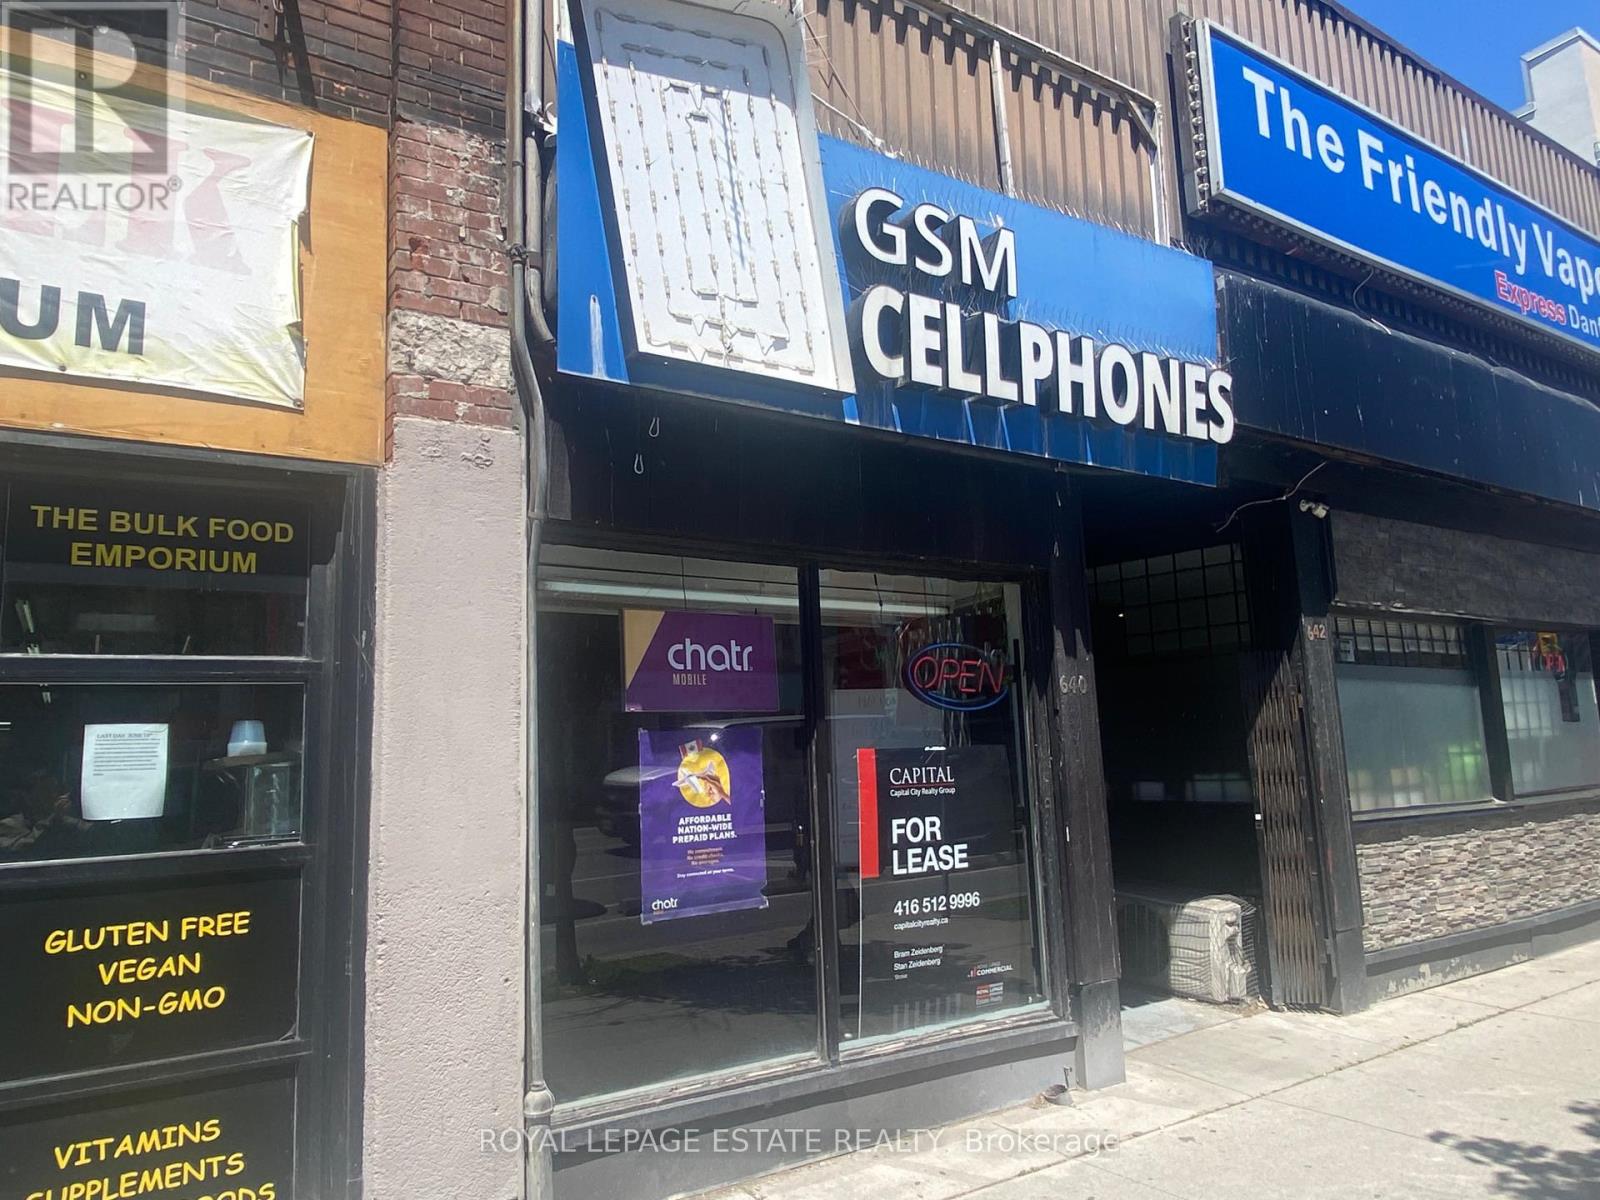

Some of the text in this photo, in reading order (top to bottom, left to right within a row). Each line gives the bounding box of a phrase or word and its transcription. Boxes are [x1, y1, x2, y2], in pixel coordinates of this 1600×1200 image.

[1242, 66, 1600, 304] The Friendly Vap
[854, 186, 1018, 298] GSM
[1494, 269, 1600, 338] Express Dan
[861, 284, 1235, 445] CELLPHONES
[30, 504, 295, 543] THE BULK FOOD
[70, 542, 258, 574] EMPORIUM
[667, 637, 754, 672] chatr
[672, 673, 708, 686] MOBILE
[913, 656, 1004, 693] OPEN
[889, 766, 955, 785] CAPITAL
[889, 786, 956, 798] Capital City Realty Group
[677, 822, 733, 834] NATION-WIDE
[678, 813, 732, 826] AFFORDABLE
[891, 816, 942, 844] FOR
[672, 830, 738, 844] PREPAID PLANS.
[892, 843, 969, 875] LEASE
[651, 897, 678, 911] chatr
[893, 891, 981, 916] 416 512 9996
[44, 911, 251, 954] GLUTEN FREE
[98, 952, 201, 986] VEGAN
[893, 949, 910, 959] Bram
[893, 962, 908, 971] Stan
[66, 986, 226, 1028] NON-GMO
[54, 1119, 221, 1170] VITAMINS
